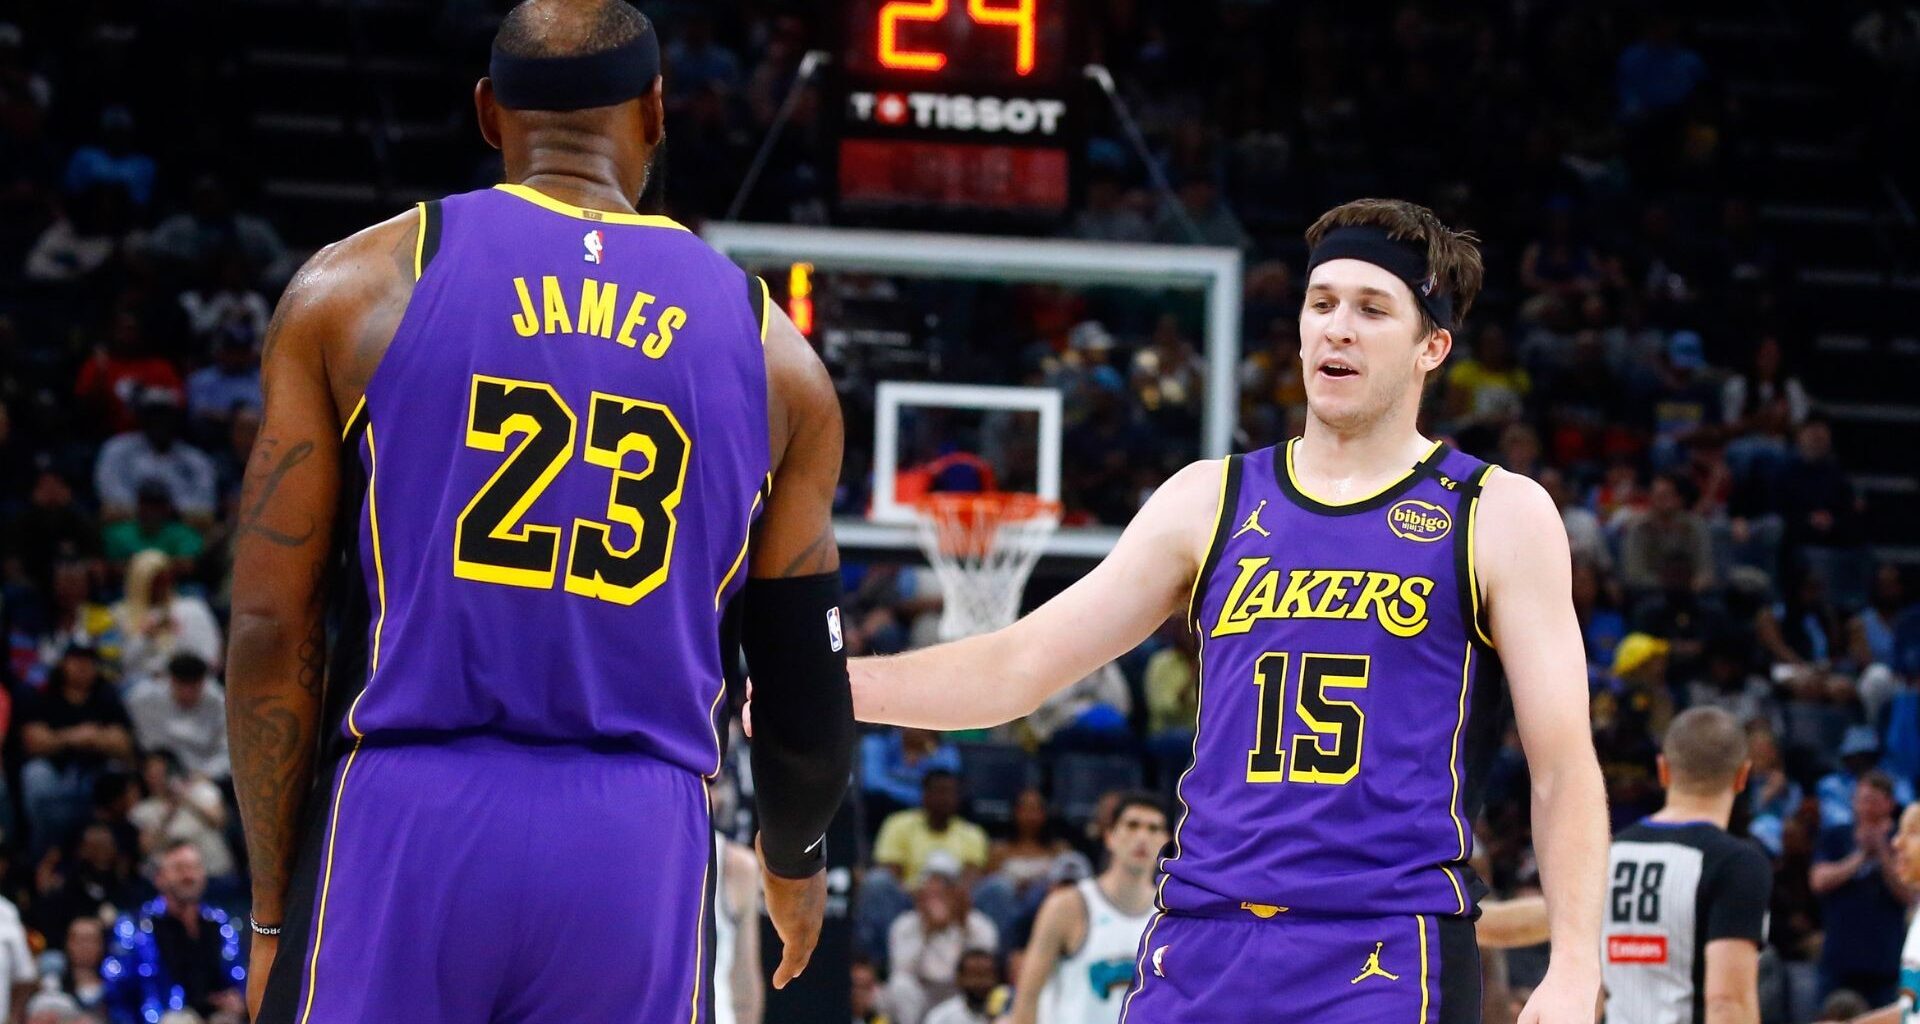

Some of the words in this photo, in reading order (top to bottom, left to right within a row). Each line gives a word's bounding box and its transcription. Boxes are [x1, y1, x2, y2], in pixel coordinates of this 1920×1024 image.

[877, 0, 1037, 76] 24
[907, 93, 1066, 136] TISSOT
[511, 275, 687, 360] JAMES
[453, 373, 692, 606] 23
[1393, 508, 1448, 532] bibigo
[1209, 556, 1436, 639] LAKERS
[1245, 651, 1371, 785] 15
[1610, 861, 1666, 923] 28
